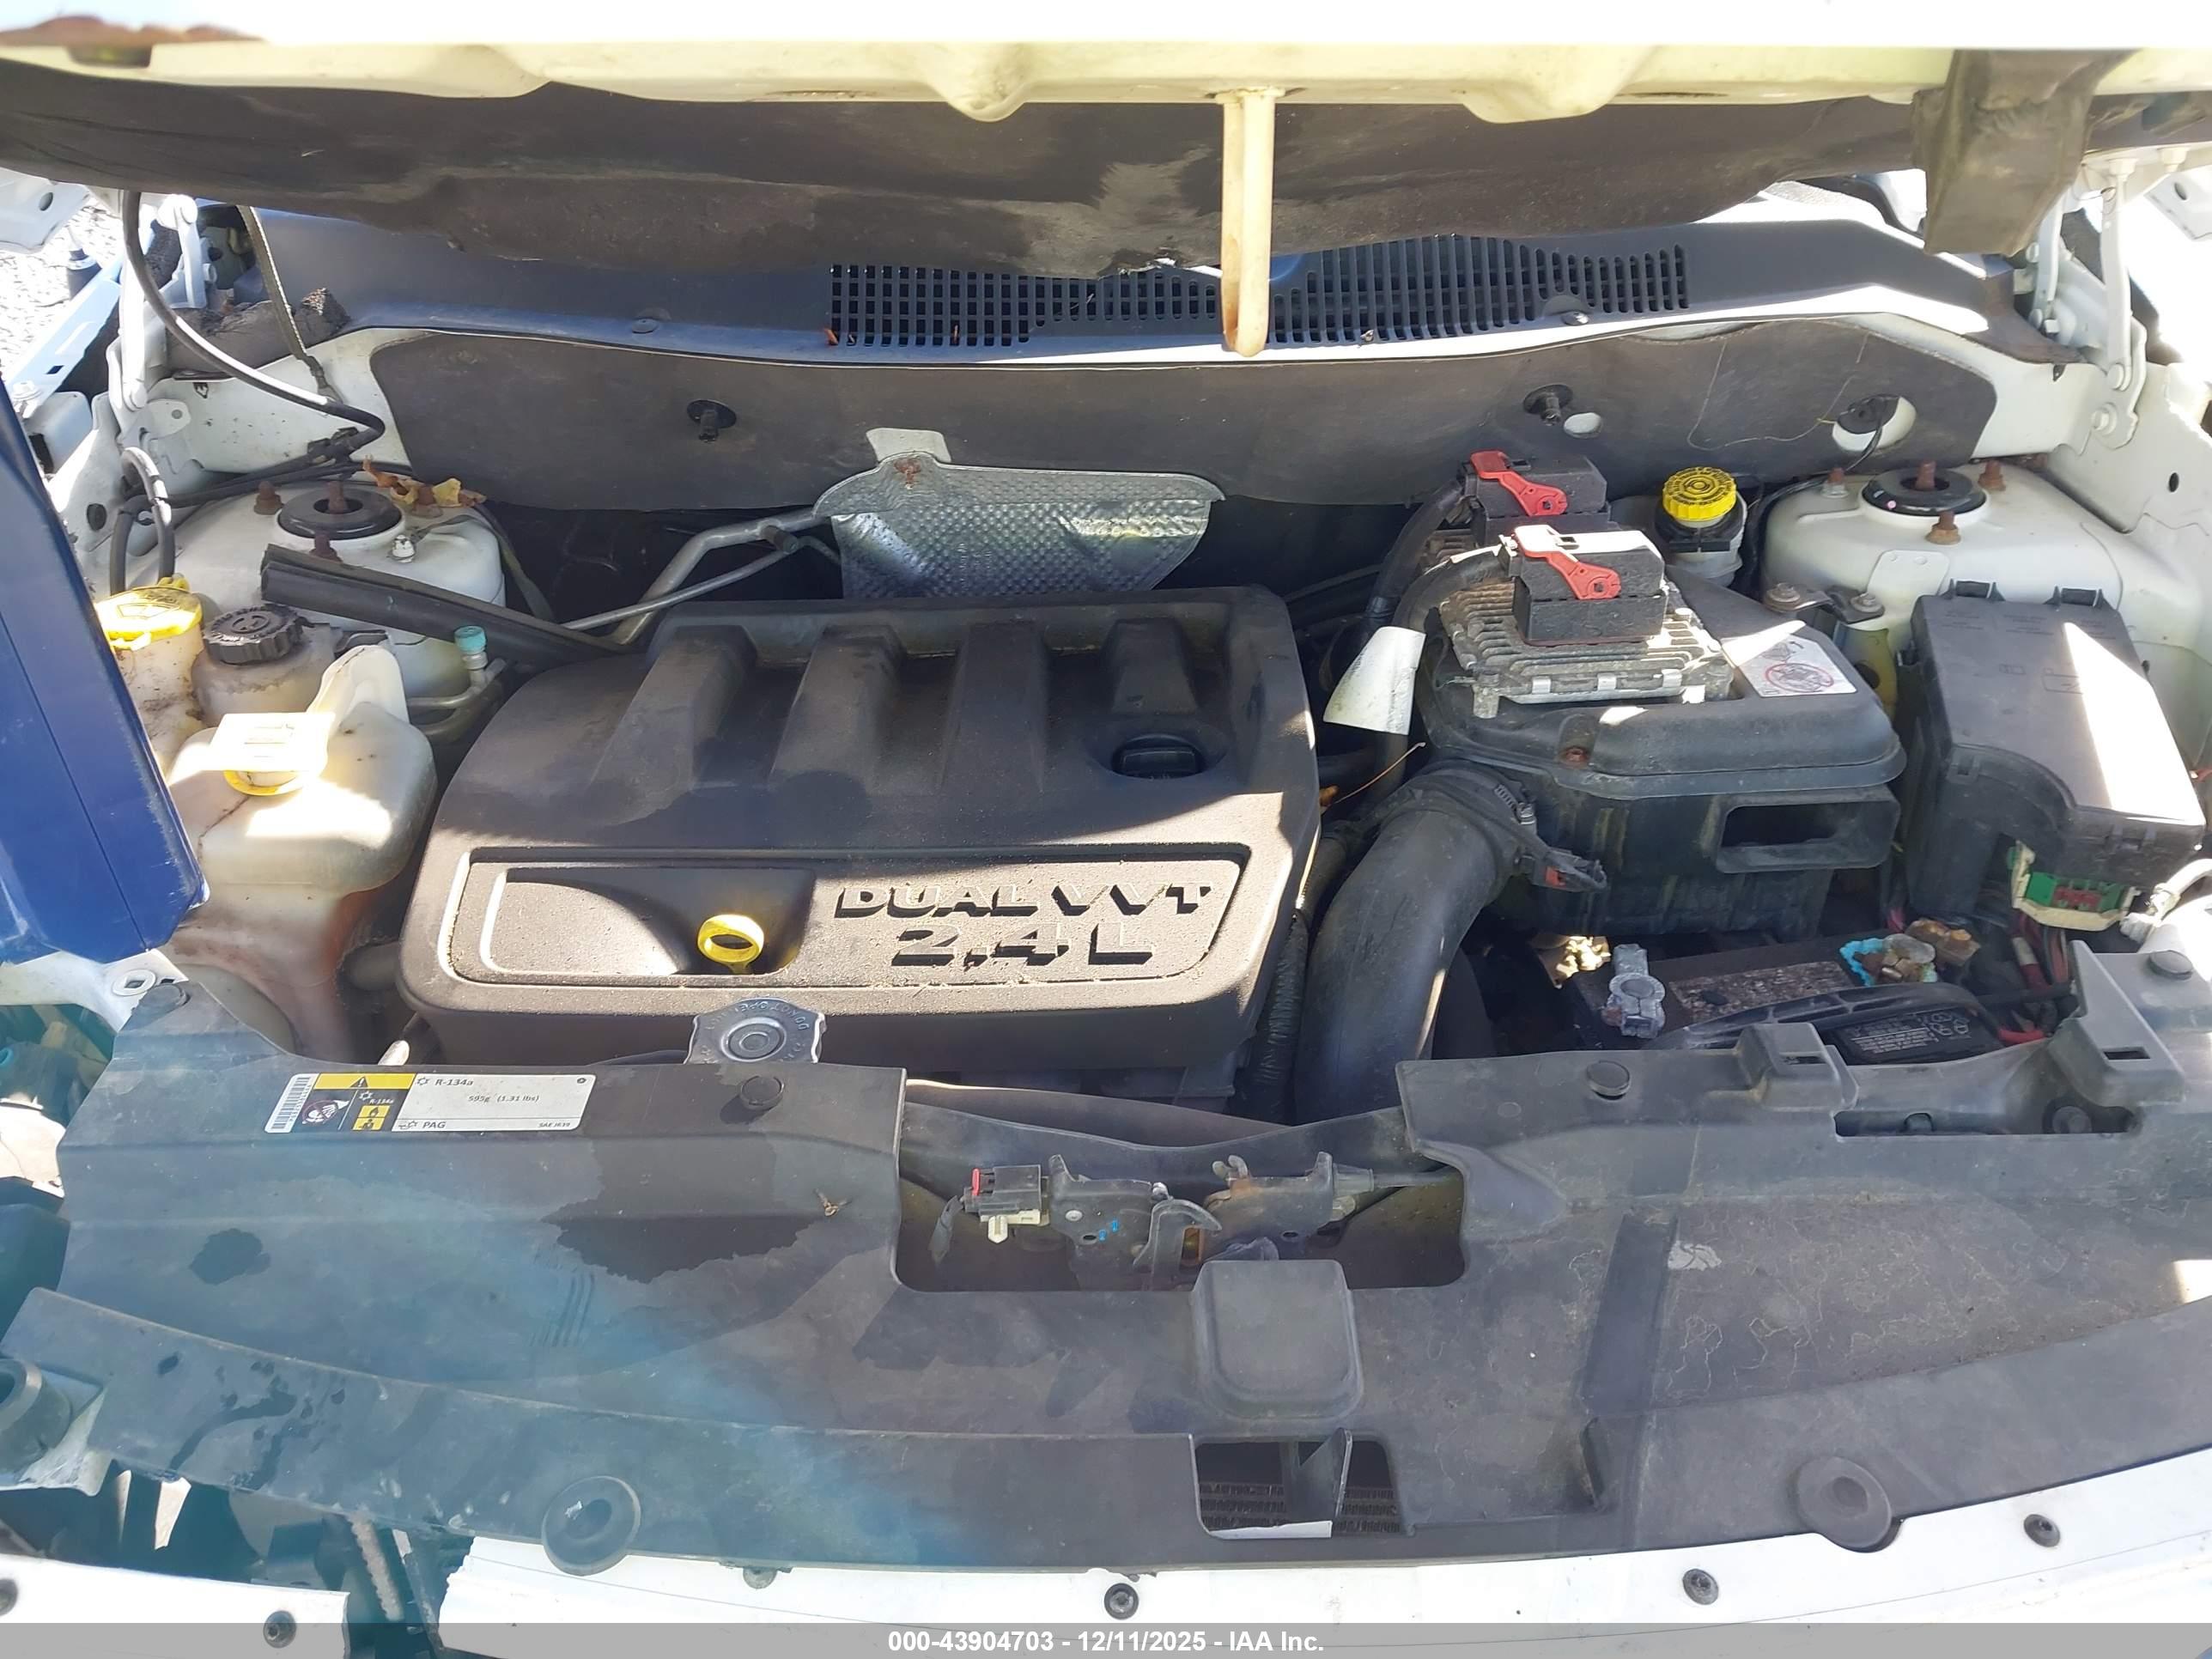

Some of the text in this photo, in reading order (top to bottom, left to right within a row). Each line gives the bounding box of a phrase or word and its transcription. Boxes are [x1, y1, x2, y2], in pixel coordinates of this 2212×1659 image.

[834, 882, 1213, 918] DUAL VVT
[890, 921, 1154, 967] 2.4L
[434, 1078, 474, 1086] R-134a
[522, 1094, 540, 1103] lbs)
[422, 1121, 447, 1129] PAG
